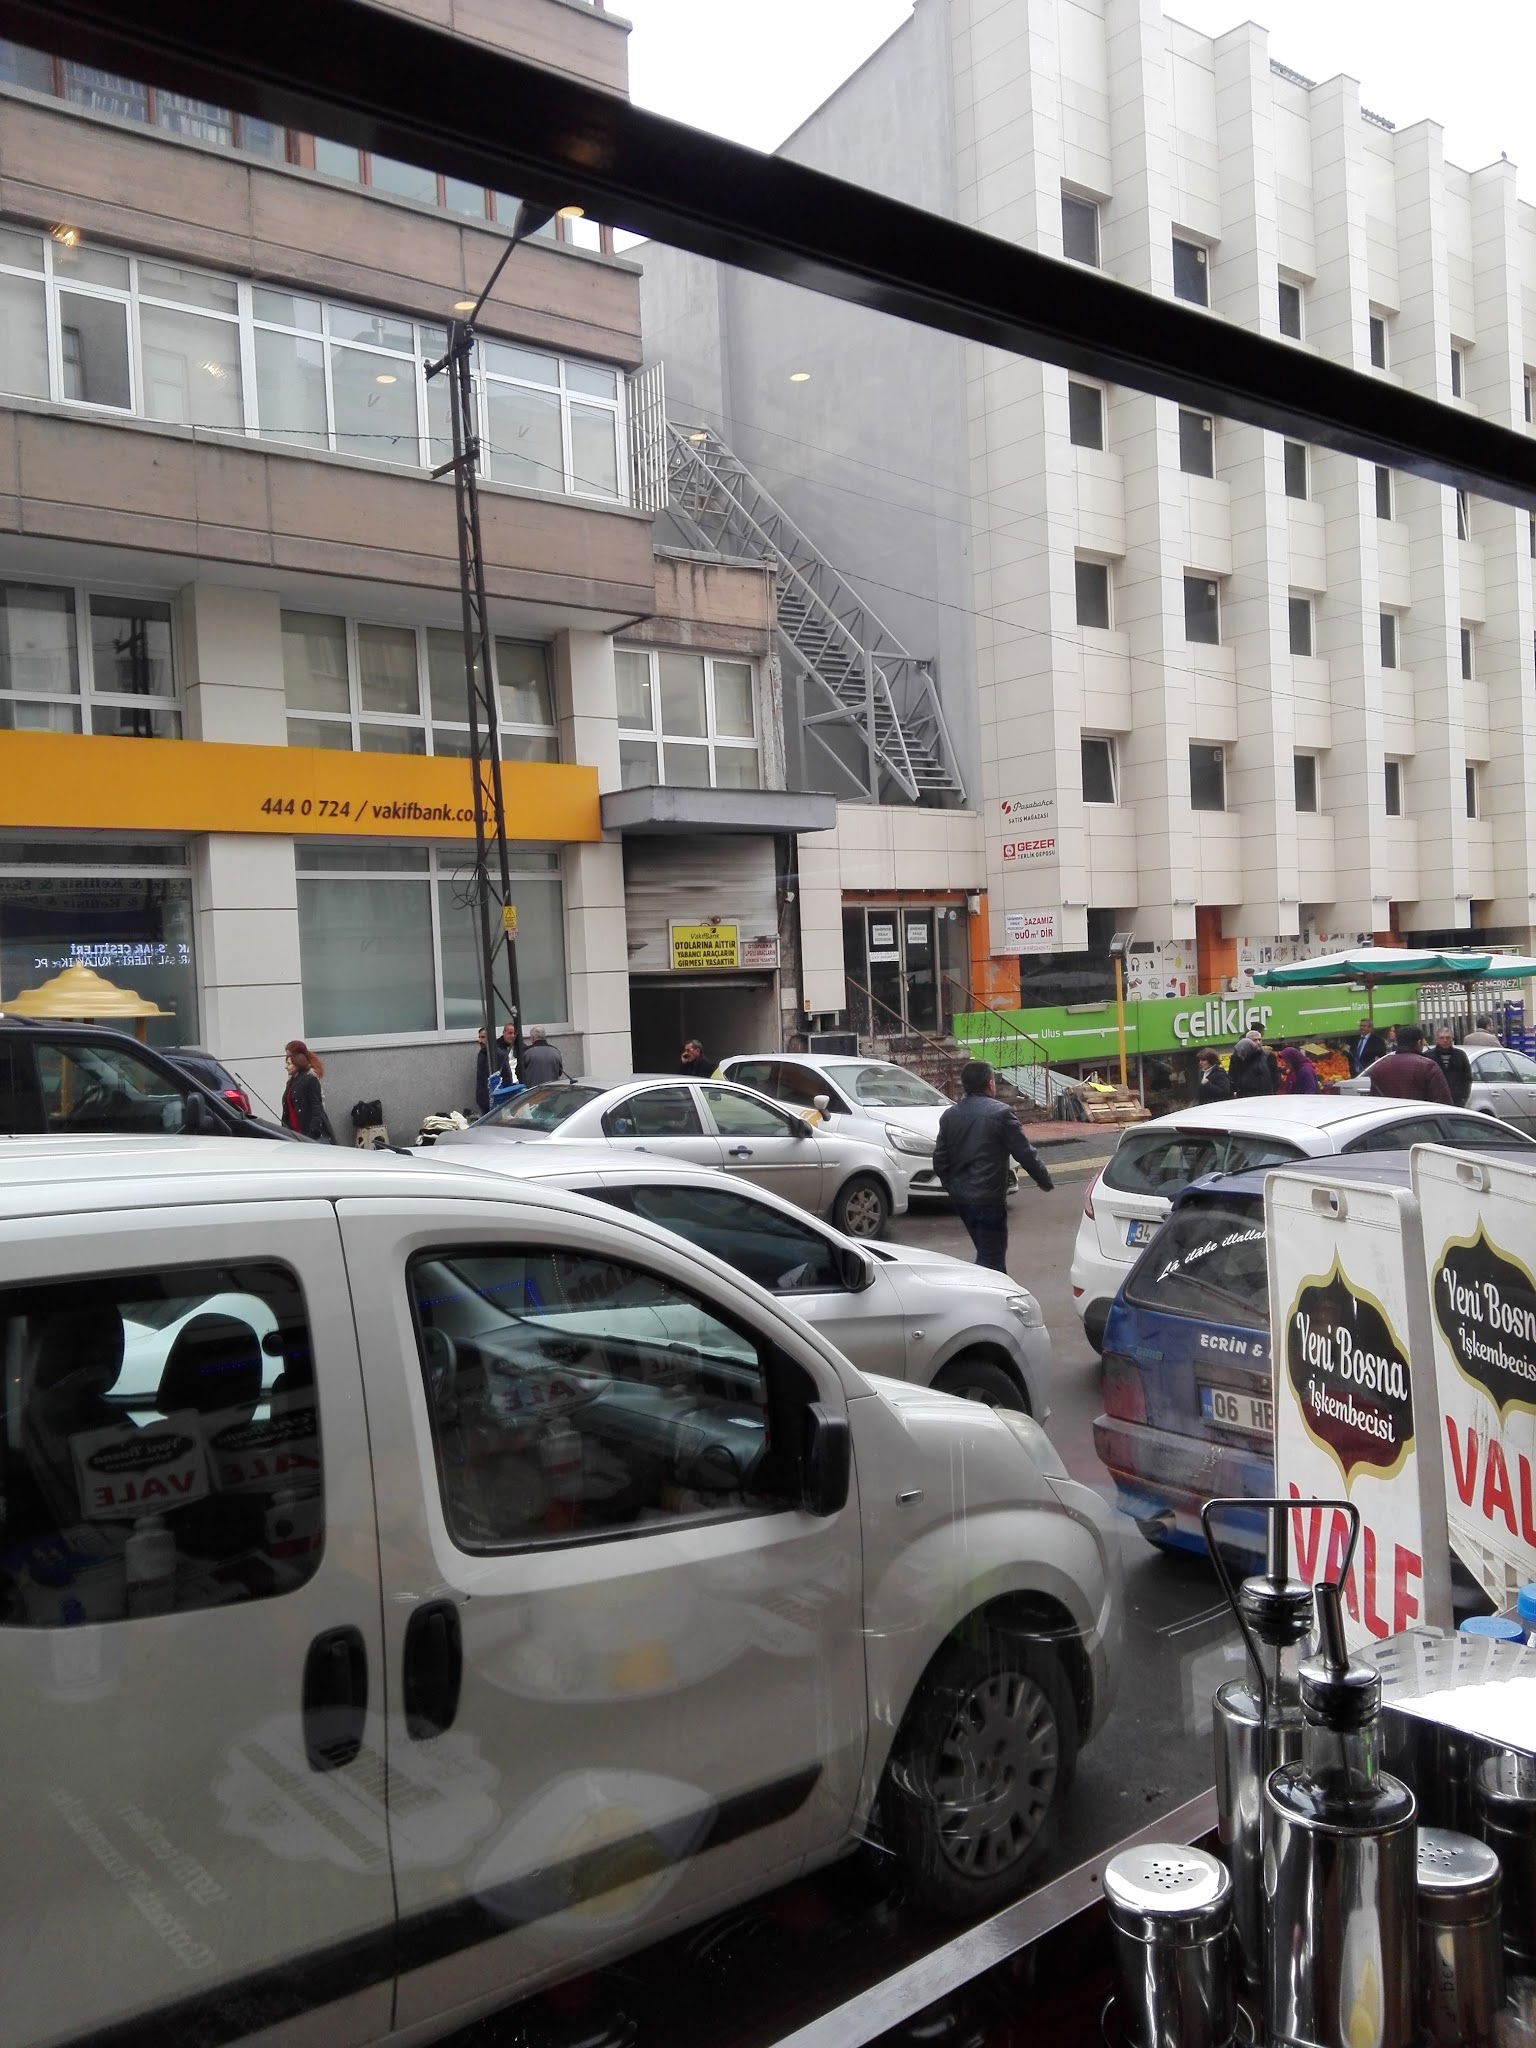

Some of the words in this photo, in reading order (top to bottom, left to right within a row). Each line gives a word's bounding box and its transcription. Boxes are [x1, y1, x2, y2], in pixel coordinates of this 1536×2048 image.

[261, 797, 295, 815] 444
[301, 799, 312, 816] 0
[318, 800, 350, 817] 724
[372, 802, 505, 823] vakifbank.co.
[1017, 839, 1055, 852] GEZER
[1040, 926, 1053, 938] DİR
[675, 941, 713, 950] OTOLARINA
[677, 950, 702, 959] YABANCI
[702, 949, 735, 958] ARAÇLARIN
[706, 957, 735, 967] YASAKTIR
[1041, 1029, 1061, 1039] Ulus
[1136, 1223, 1151, 1241] 34
[1184, 1241, 1218, 1264] ilâhe
[1443, 1267, 1484, 1323] Yeni
[1484, 1282, 1536, 1346] Bosn
[1200, 1334, 1248, 1355] ECRİN
[1252, 1344, 1263, 1357] &
[1297, 1311, 1335, 1373] Yeni
[1336, 1326, 1408, 1401] Bosna
[1458, 1322, 1536, 1382] İşkembecis
[1214, 1393, 1239, 1422] 06
[1308, 1374, 1396, 1443] İşkembecisi
[1445, 1415, 1536, 1549] VAL
